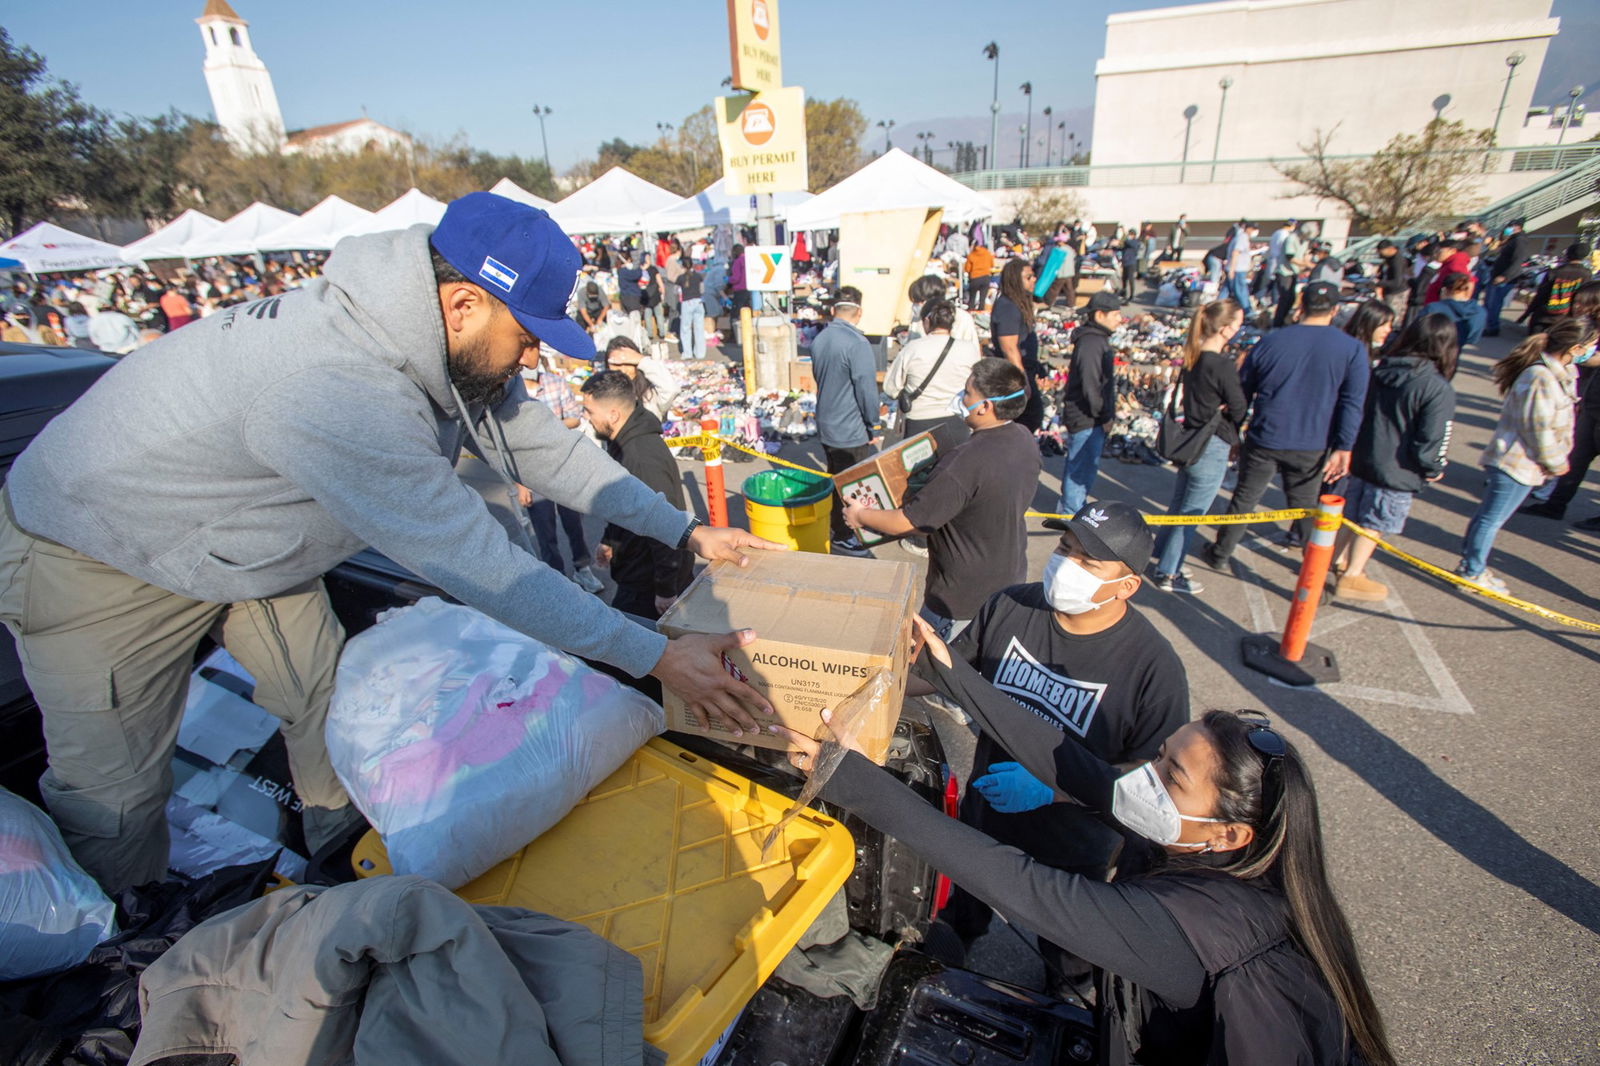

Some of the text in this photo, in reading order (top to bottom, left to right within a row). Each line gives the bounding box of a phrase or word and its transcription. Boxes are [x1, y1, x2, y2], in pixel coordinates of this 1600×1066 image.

[730, 151, 796, 168] BUY PERMIT
[747, 171, 776, 184] HERE
[752, 652, 868, 678] ALCOHOL WIPES
[774, 683, 803, 692] CONTAINING
[804, 688, 833, 697] FLAMMABLE
[791, 679, 820, 689] UN3175
[1001, 651, 1095, 724] HOMEBOY
[248, 775, 292, 806] WEST
